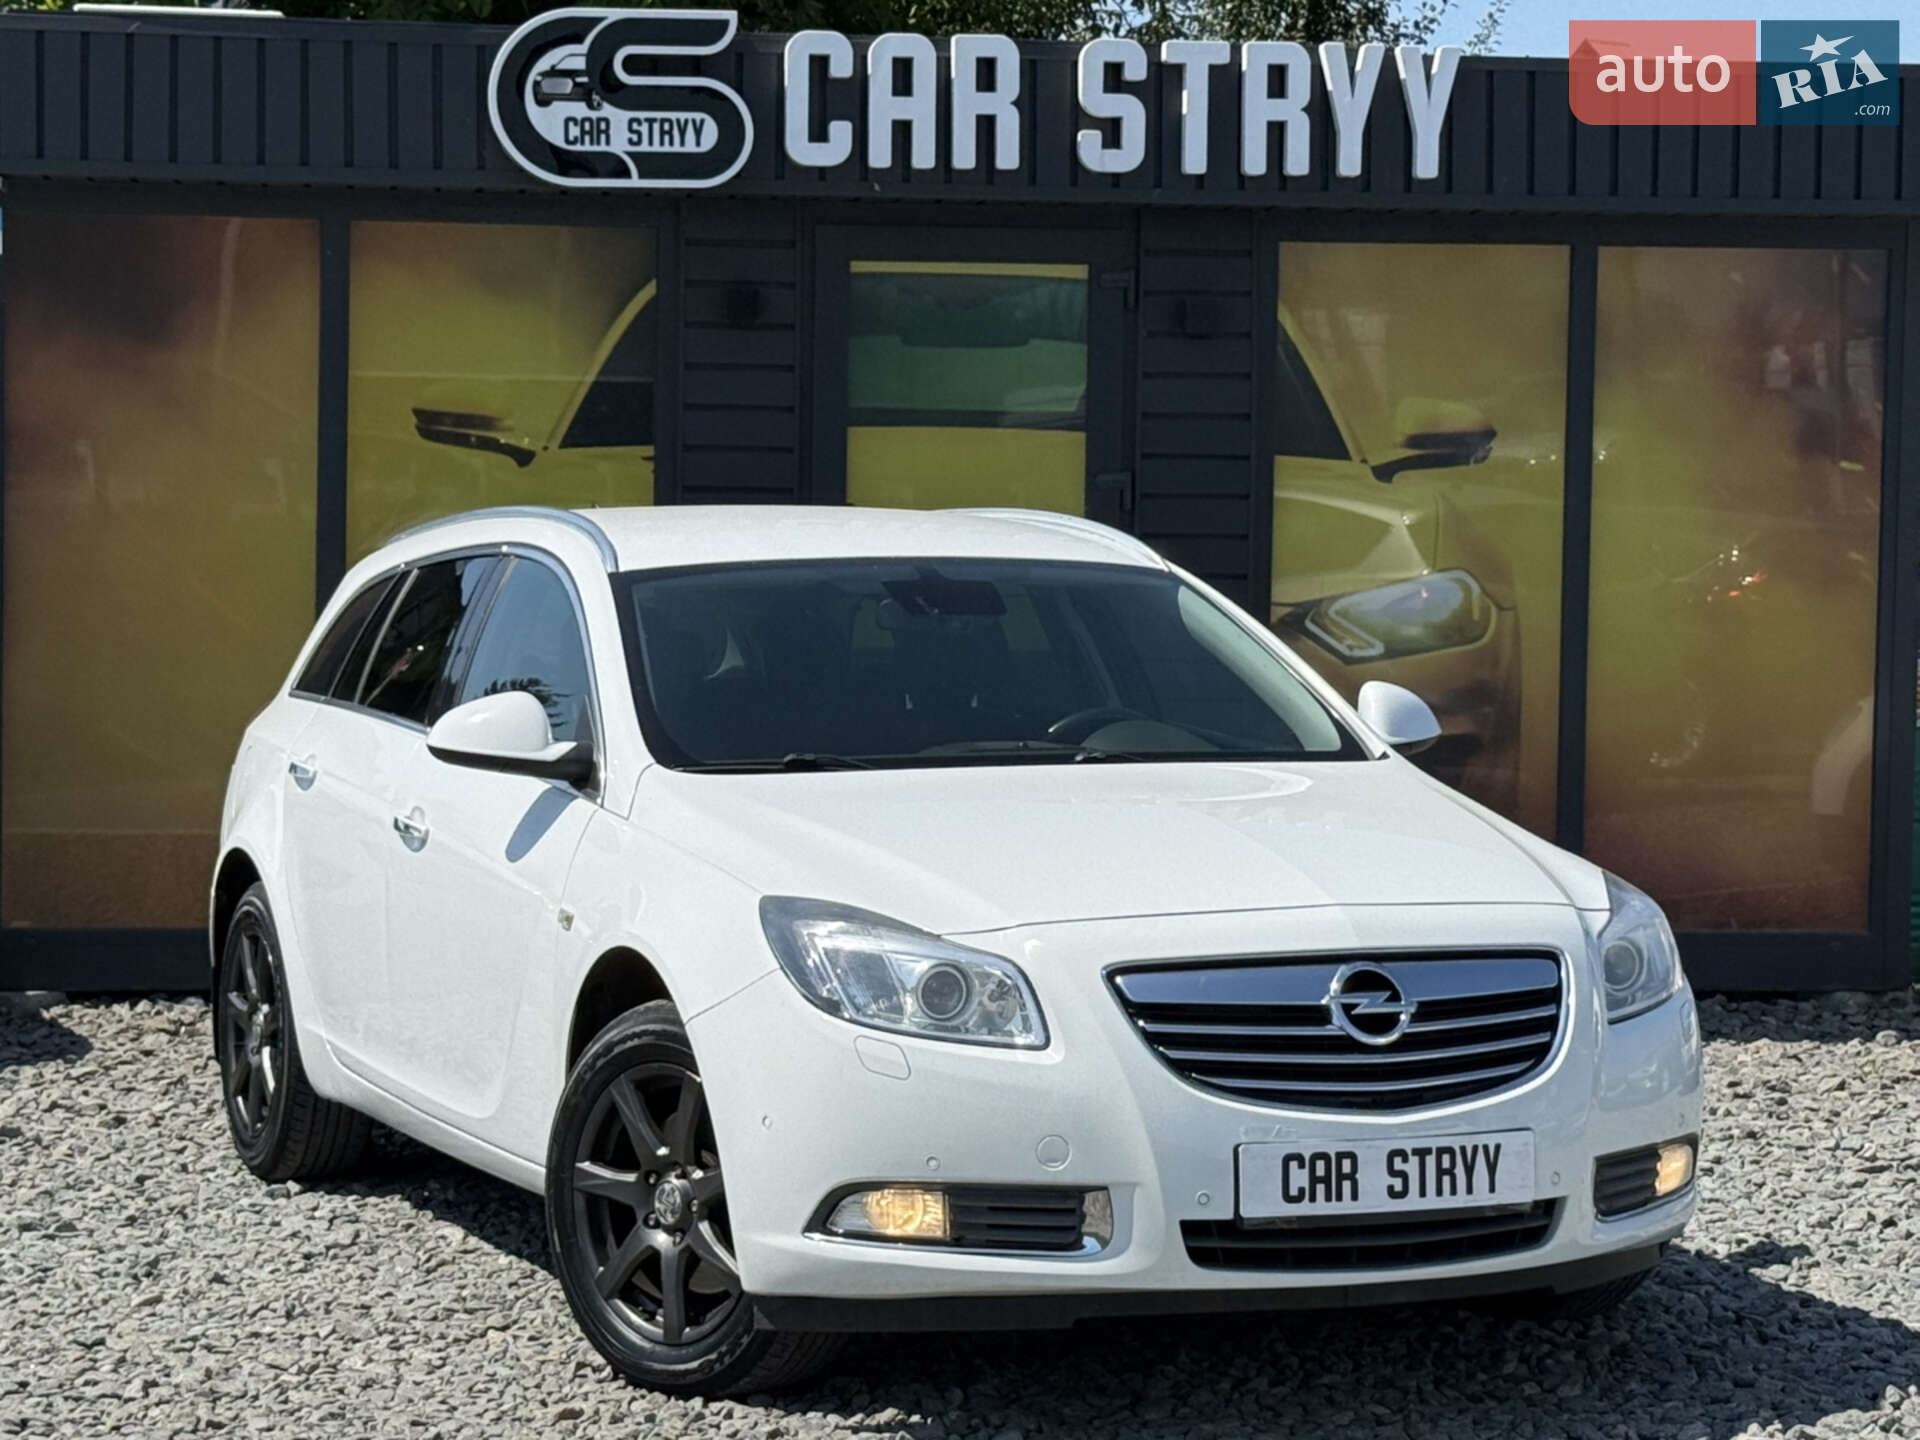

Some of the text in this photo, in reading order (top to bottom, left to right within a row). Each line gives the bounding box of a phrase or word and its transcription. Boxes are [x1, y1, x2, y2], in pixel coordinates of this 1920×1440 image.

[563, 115, 706, 147] CAR STRYY
[784, 30, 1463, 179] CAR STRYY
[1281, 1143, 1502, 1204] CAR STRYY
